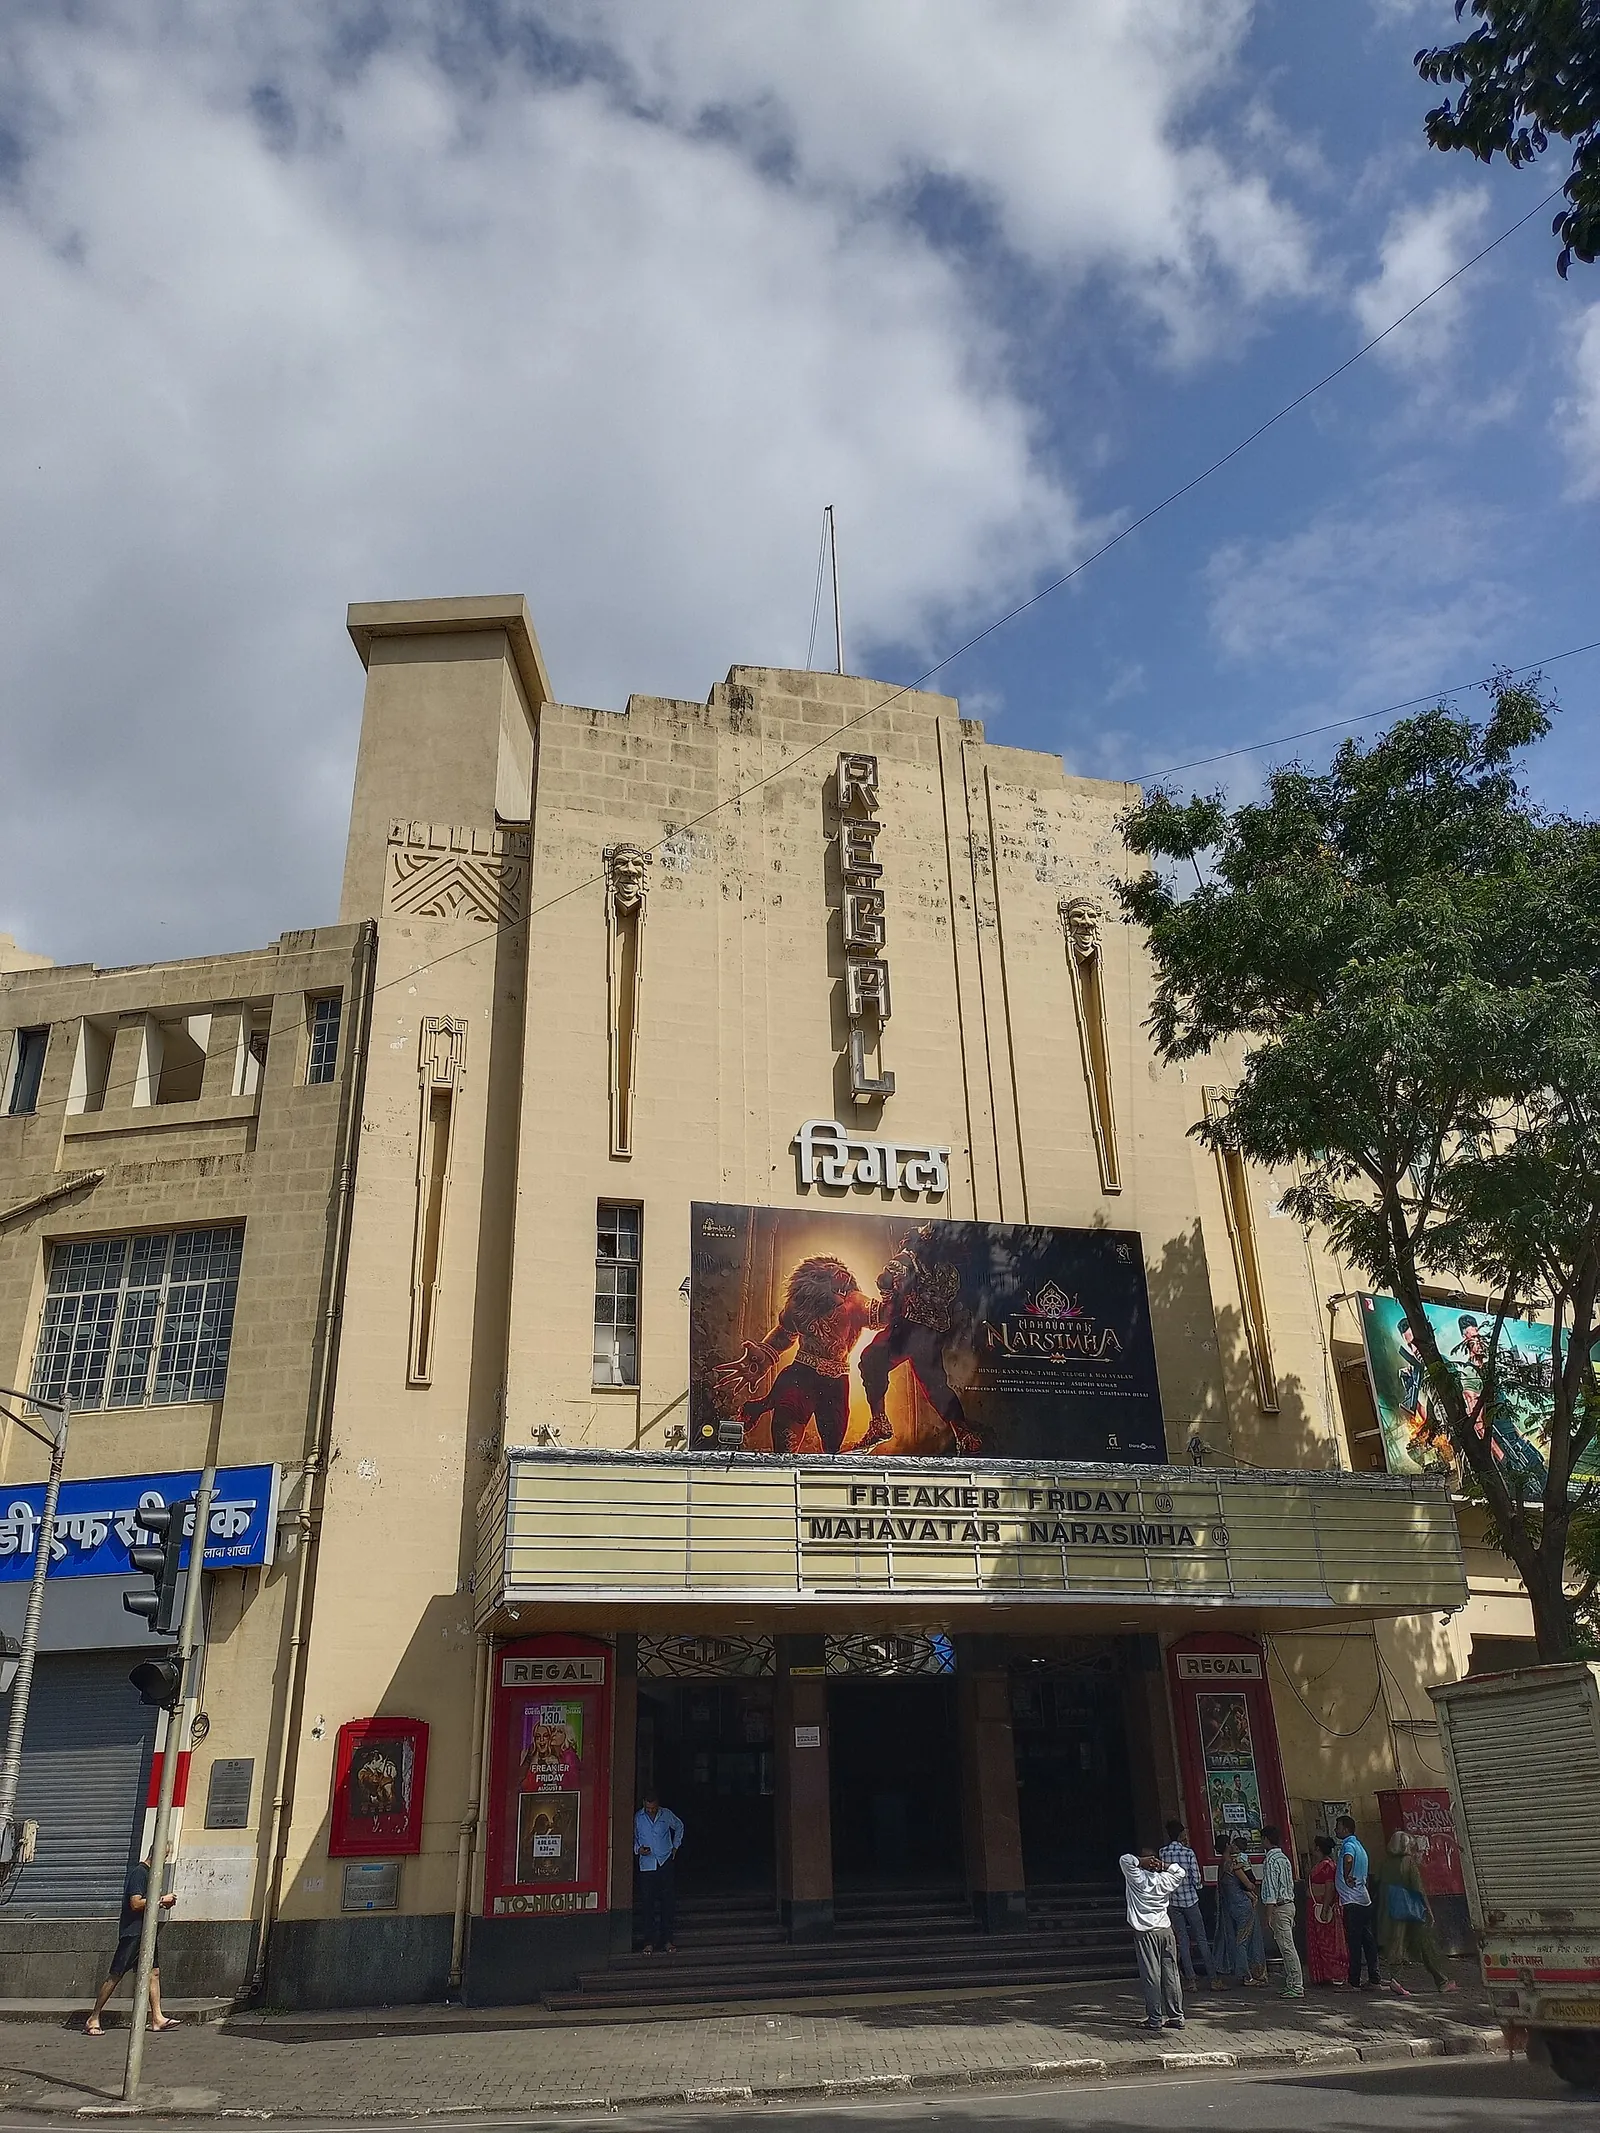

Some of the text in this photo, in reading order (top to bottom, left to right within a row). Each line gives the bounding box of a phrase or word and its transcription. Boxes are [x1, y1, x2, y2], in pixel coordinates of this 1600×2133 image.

[836, 751, 896, 1101] REGAL
[792, 1119, 952, 1193] रिगल
[1018, 1319, 1092, 1335] MAHAVATAR
[981, 1320, 1124, 1357] NARSIMHA
[850, 1484, 1001, 1508] FREAKIER
[1028, 1487, 1132, 1513] FRIDAY
[810, 1518, 1001, 1541] MAHAVATAR
[1030, 1521, 1196, 1546] NARASIMHA
[513, 1663, 593, 1681] REGAL
[1186, 1659, 1253, 1674] REGAL
[531, 1764, 570, 1773] FREAKIER
[536, 1773, 565, 1782] FRIDAY
[500, 1893, 590, 1913] TO-NIGHT
